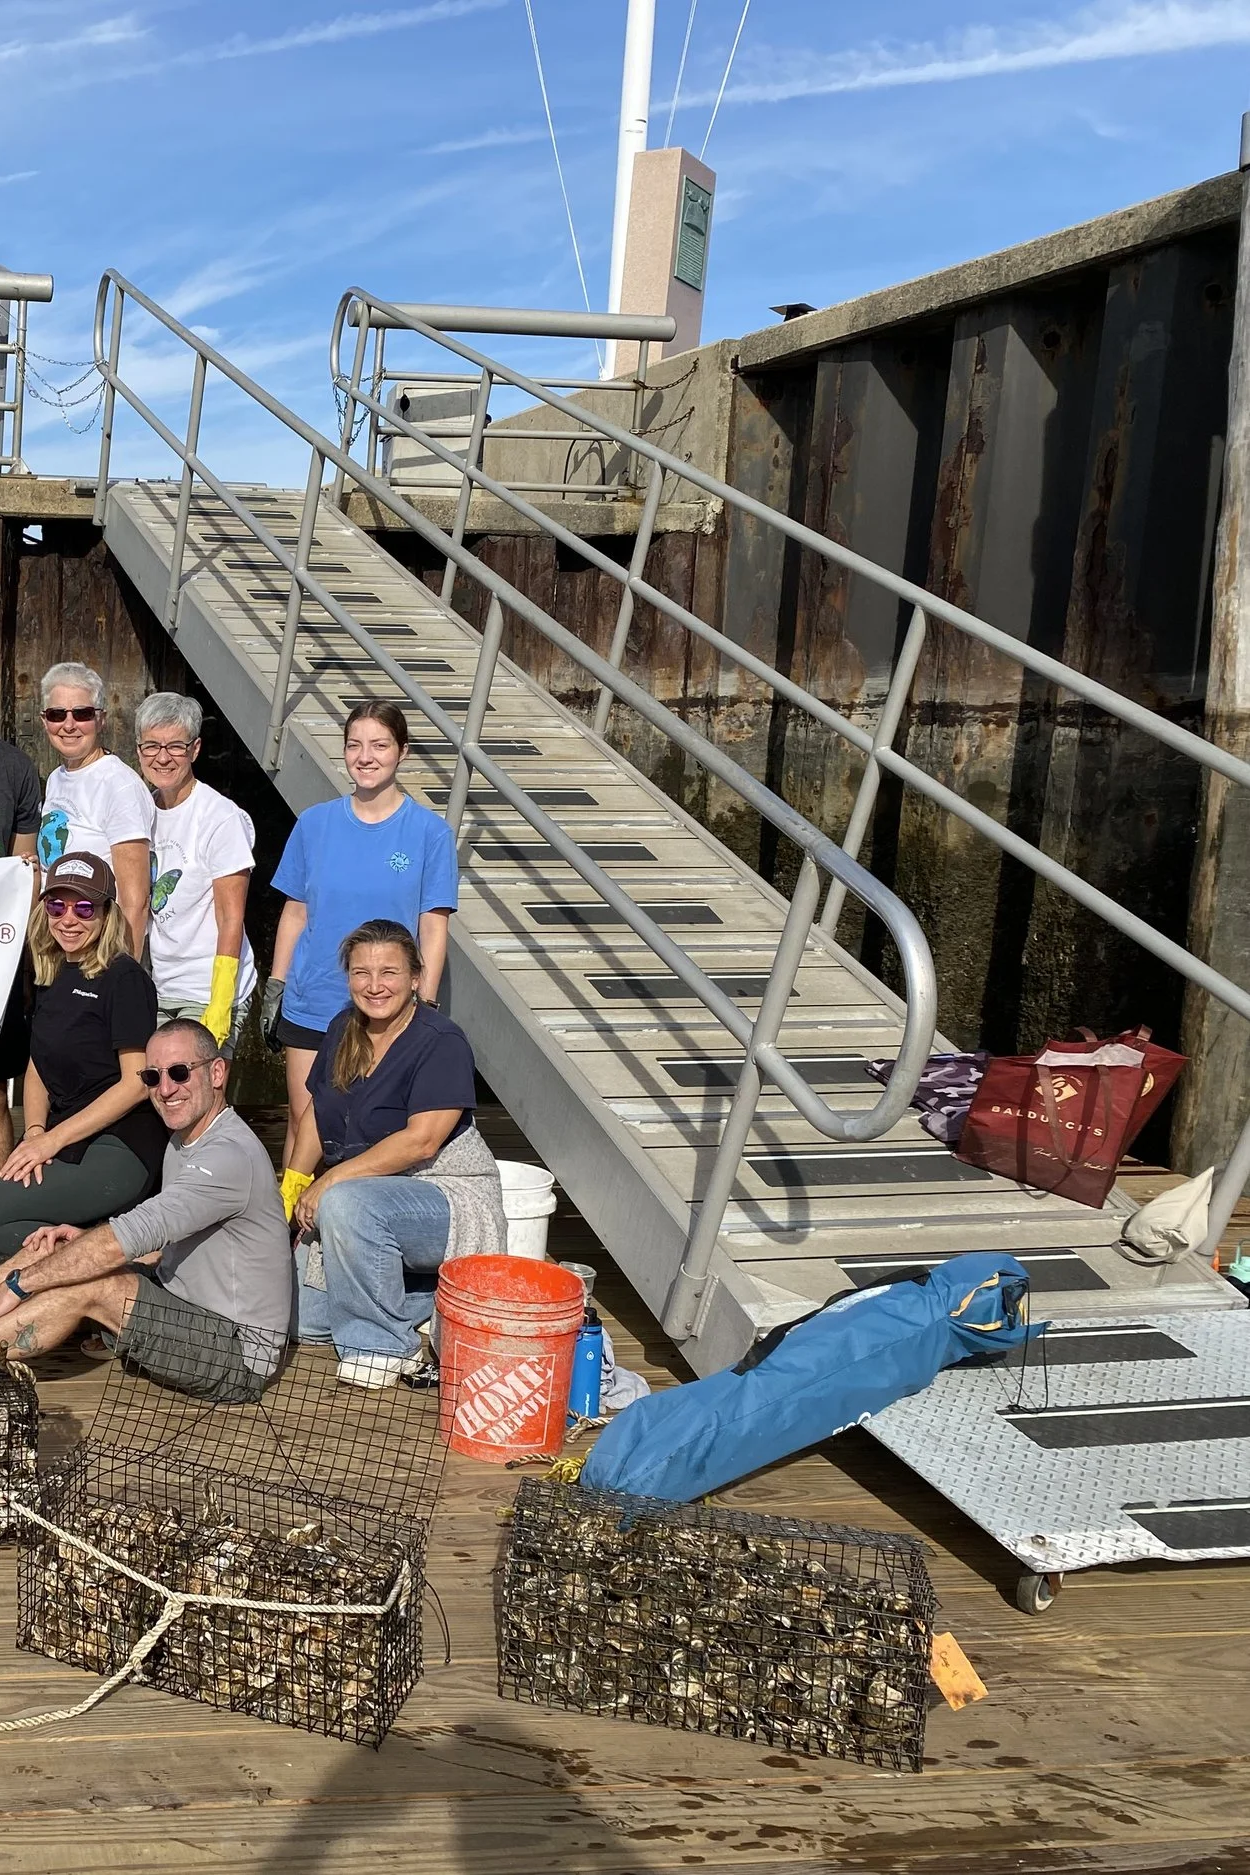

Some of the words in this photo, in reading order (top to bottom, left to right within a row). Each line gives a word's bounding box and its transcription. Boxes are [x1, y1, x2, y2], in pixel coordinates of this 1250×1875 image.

[991, 1105, 1104, 1137] BALDUCI'S
[455, 1357, 553, 1437] HOME
[461, 1361, 503, 1394] THE
[485, 1389, 550, 1444] DEPOT
